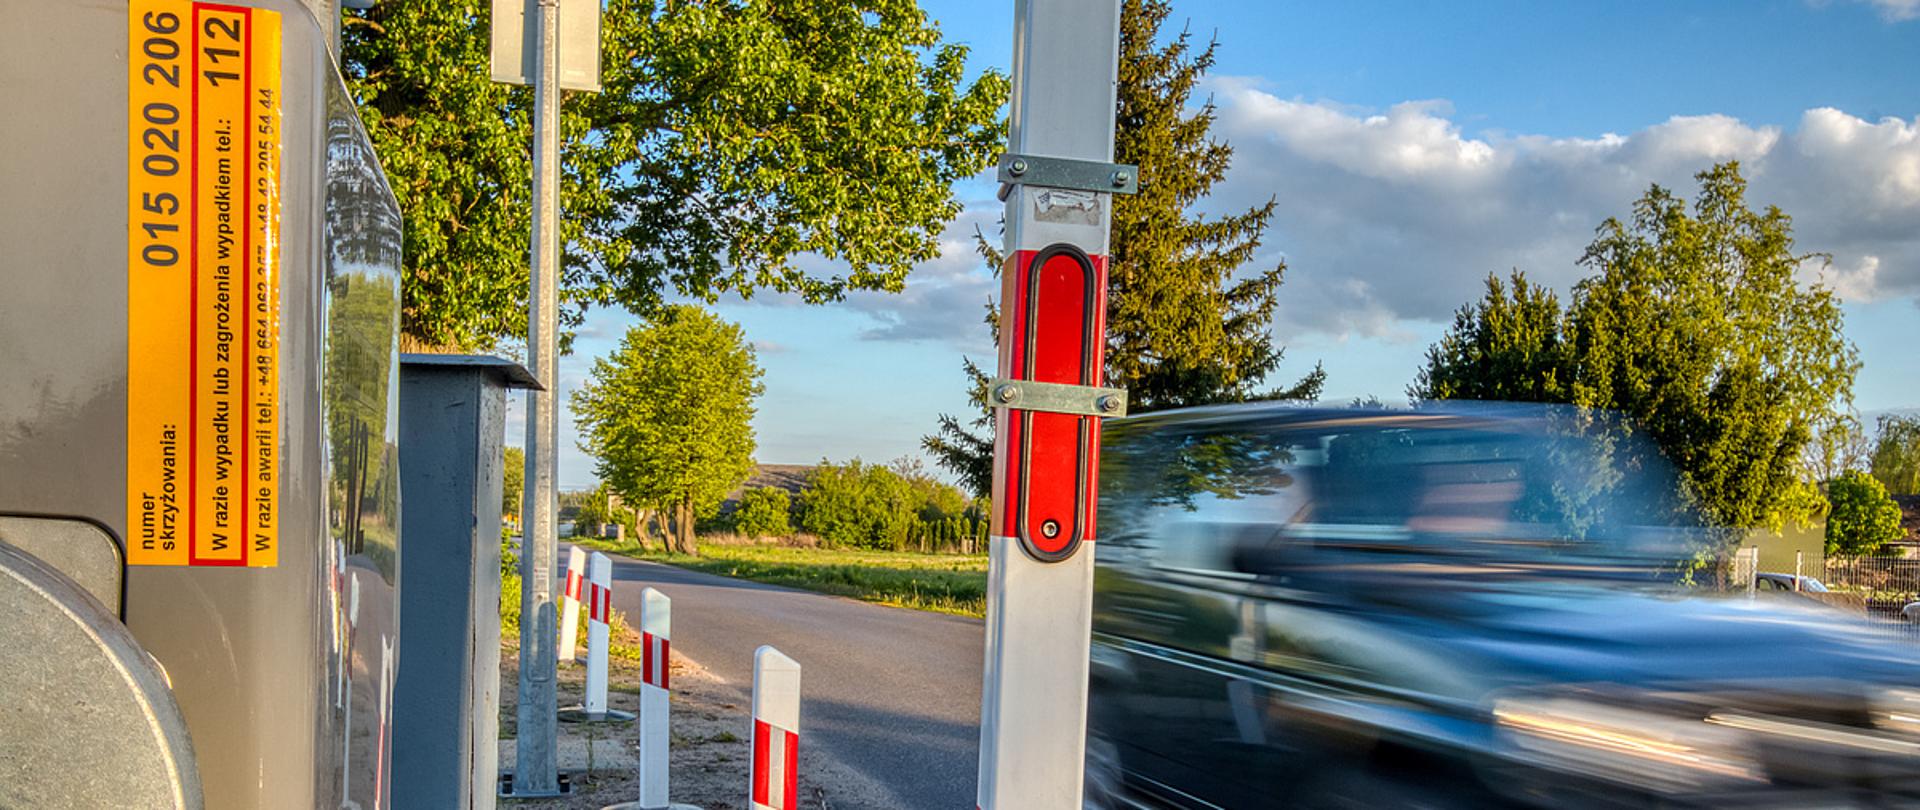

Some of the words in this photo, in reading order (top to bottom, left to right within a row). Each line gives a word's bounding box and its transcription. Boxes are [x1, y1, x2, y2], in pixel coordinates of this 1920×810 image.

[143, 11, 180, 89] 206
[203, 17, 241, 87] 112
[259, 88, 274, 110] 44
[142, 102, 180, 177] 020
[215, 119, 231, 152] tel.:
[258, 115, 274, 136] 54
[258, 140, 273, 172] 205
[214, 158, 234, 259] wypadkiem
[142, 192, 179, 267] 015
[213, 265, 233, 362] zagrożenia
[257, 319, 272, 349] 664
[213, 367, 229, 395] lub
[257, 355, 272, 386] +48
[256, 392, 272, 424] tel.:
[213, 401, 233, 480] wypadku
[256, 430, 271, 481] awarii
[160, 424, 179, 551] skrzyżowania:
[212, 486, 228, 528] razie
[255, 487, 271, 528] razie
[142, 492, 155, 550] numer
[212, 533, 228, 551] W
[255, 534, 271, 551] W
